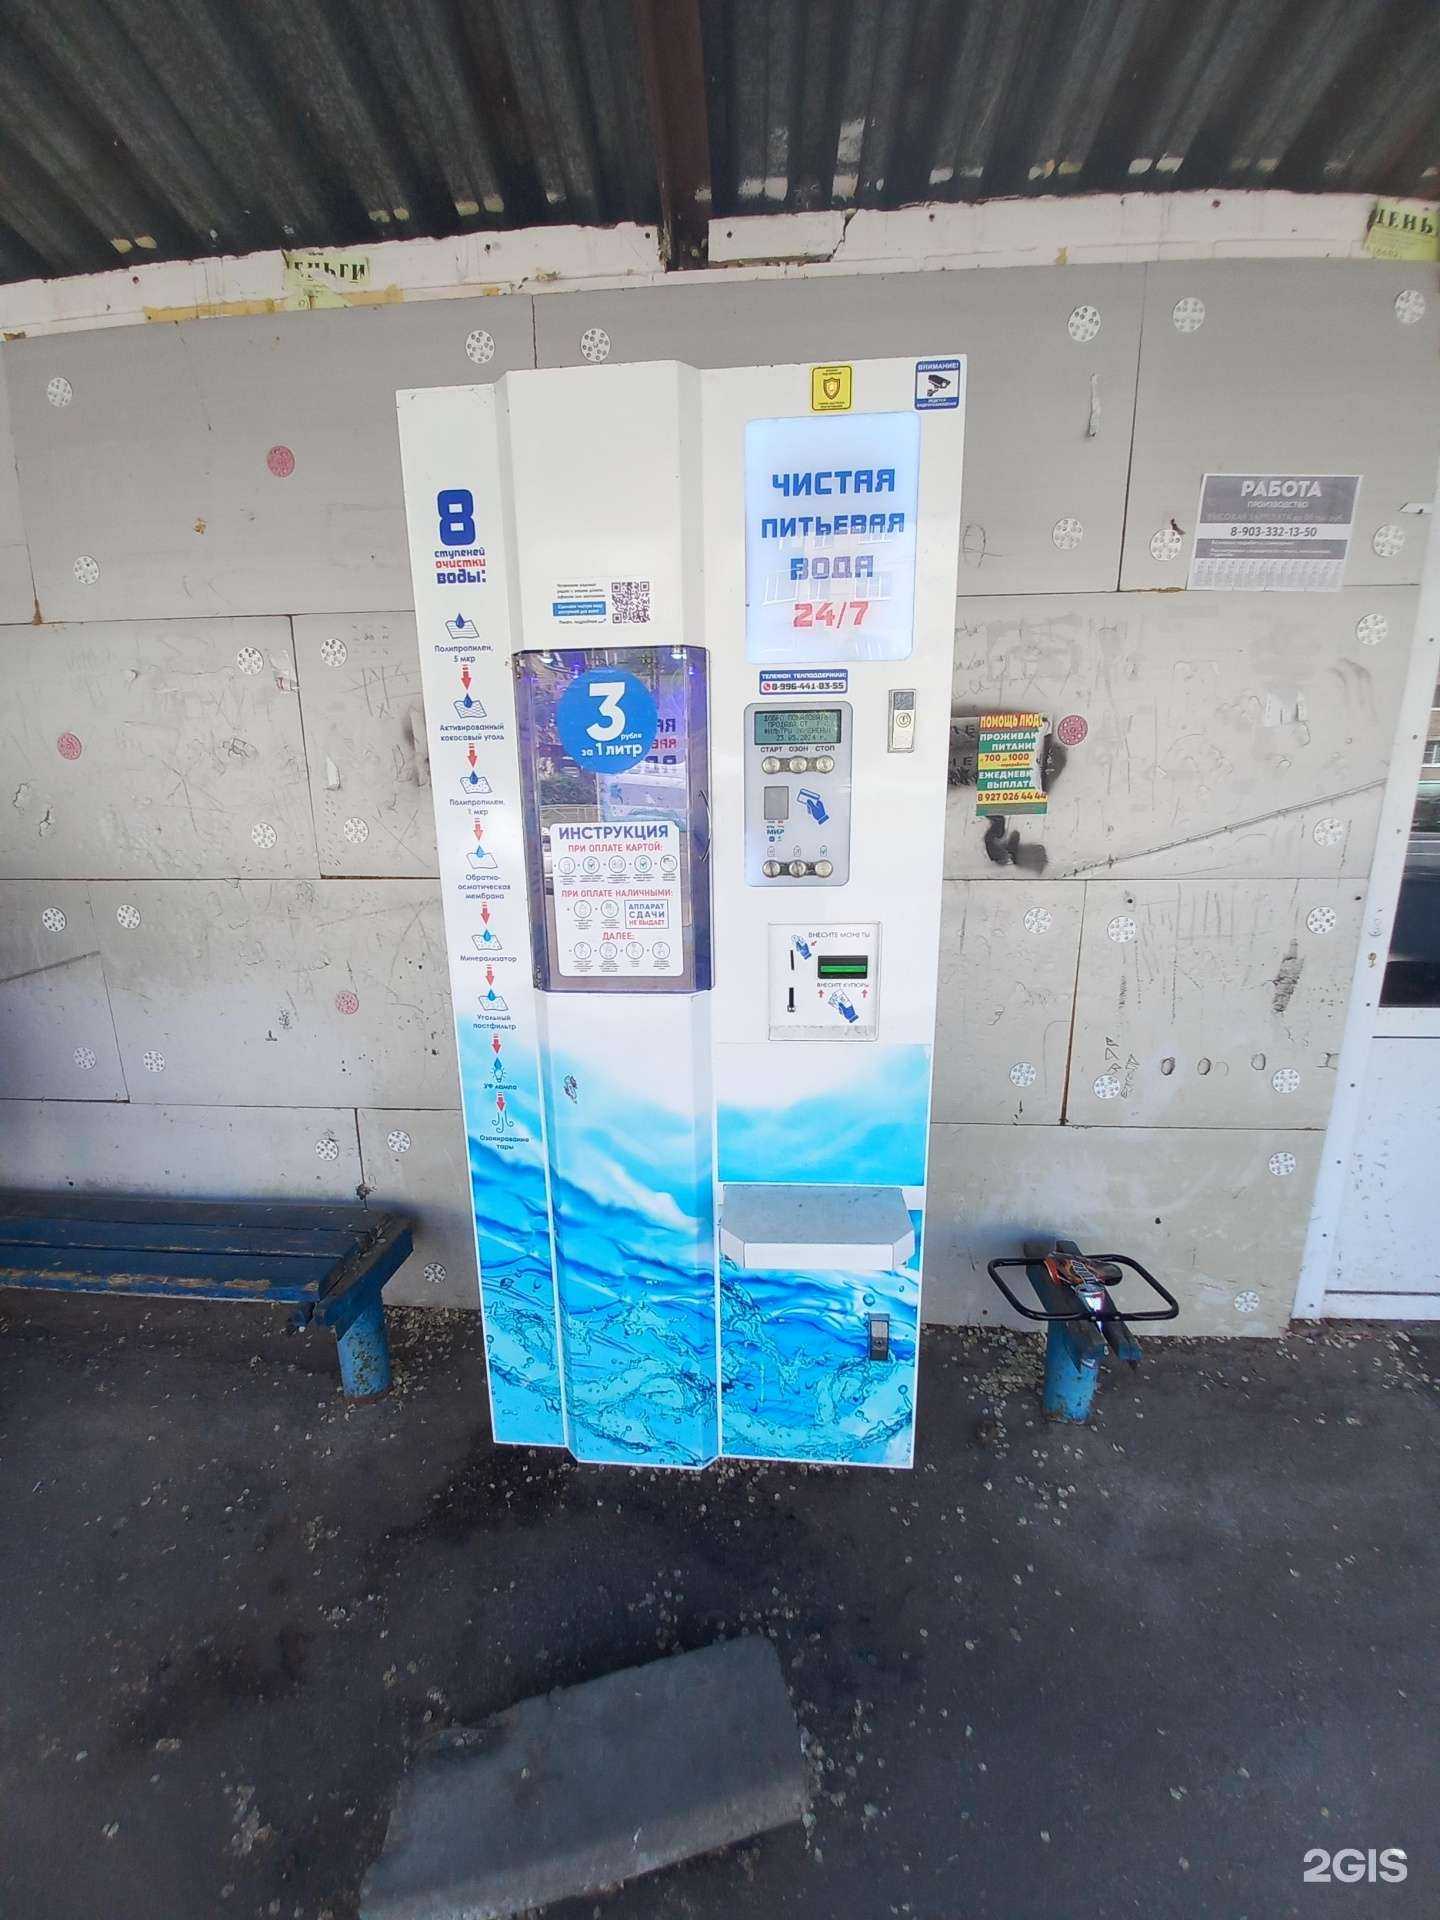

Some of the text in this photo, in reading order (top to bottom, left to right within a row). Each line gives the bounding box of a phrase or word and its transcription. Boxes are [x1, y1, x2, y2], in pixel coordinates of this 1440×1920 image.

[772, 467, 895, 497] ЧИСТАЯ
[1240, 480, 1322, 497] РАБОТА
[437, 489, 476, 546] 8
[761, 512, 905, 539] ПИТЬЕВАЯ
[1230, 526, 1317, 538] 8-903-332-13-50
[434, 547, 485, 559] ступеней
[435, 558, 486, 569] очистки
[790, 554, 874, 581] ВОДА
[437, 568, 487, 585] воды:
[793, 600, 870, 629] 24/7
[434, 644, 494, 654] Полипропилен,
[586, 681, 626, 742] 3
[980, 713, 1042, 729] ПОМОЩЬ ЛЮД
[440, 723, 504, 732] Активированный
[440, 733, 482, 742] кокосовый
[620, 732, 643, 741] рубля
[581, 749, 594, 757] за
[596, 742, 603, 756] 1
[605, 743, 643, 758] литр
[985, 754, 1001, 762] 700
[1009, 753, 1030, 761] 1000
[977, 793, 983, 802] 8
[985, 792, 1001, 801] 927
[1002, 792, 1019, 801] 026
[559, 824, 669, 841] ИНСТРУКЦИЯ
[568, 841, 663, 853] ПРИ ОПЛАТЕ КАРТОЙ:
[561, 888, 673, 898] ПРИ ОПЛАТЕ НАЛИЧНЫМИ:
[628, 903, 665, 911] АППАРАТ
[628, 911, 665, 919] СДАЧИ
[602, 931, 634, 941] ДАЛЕЕ:
